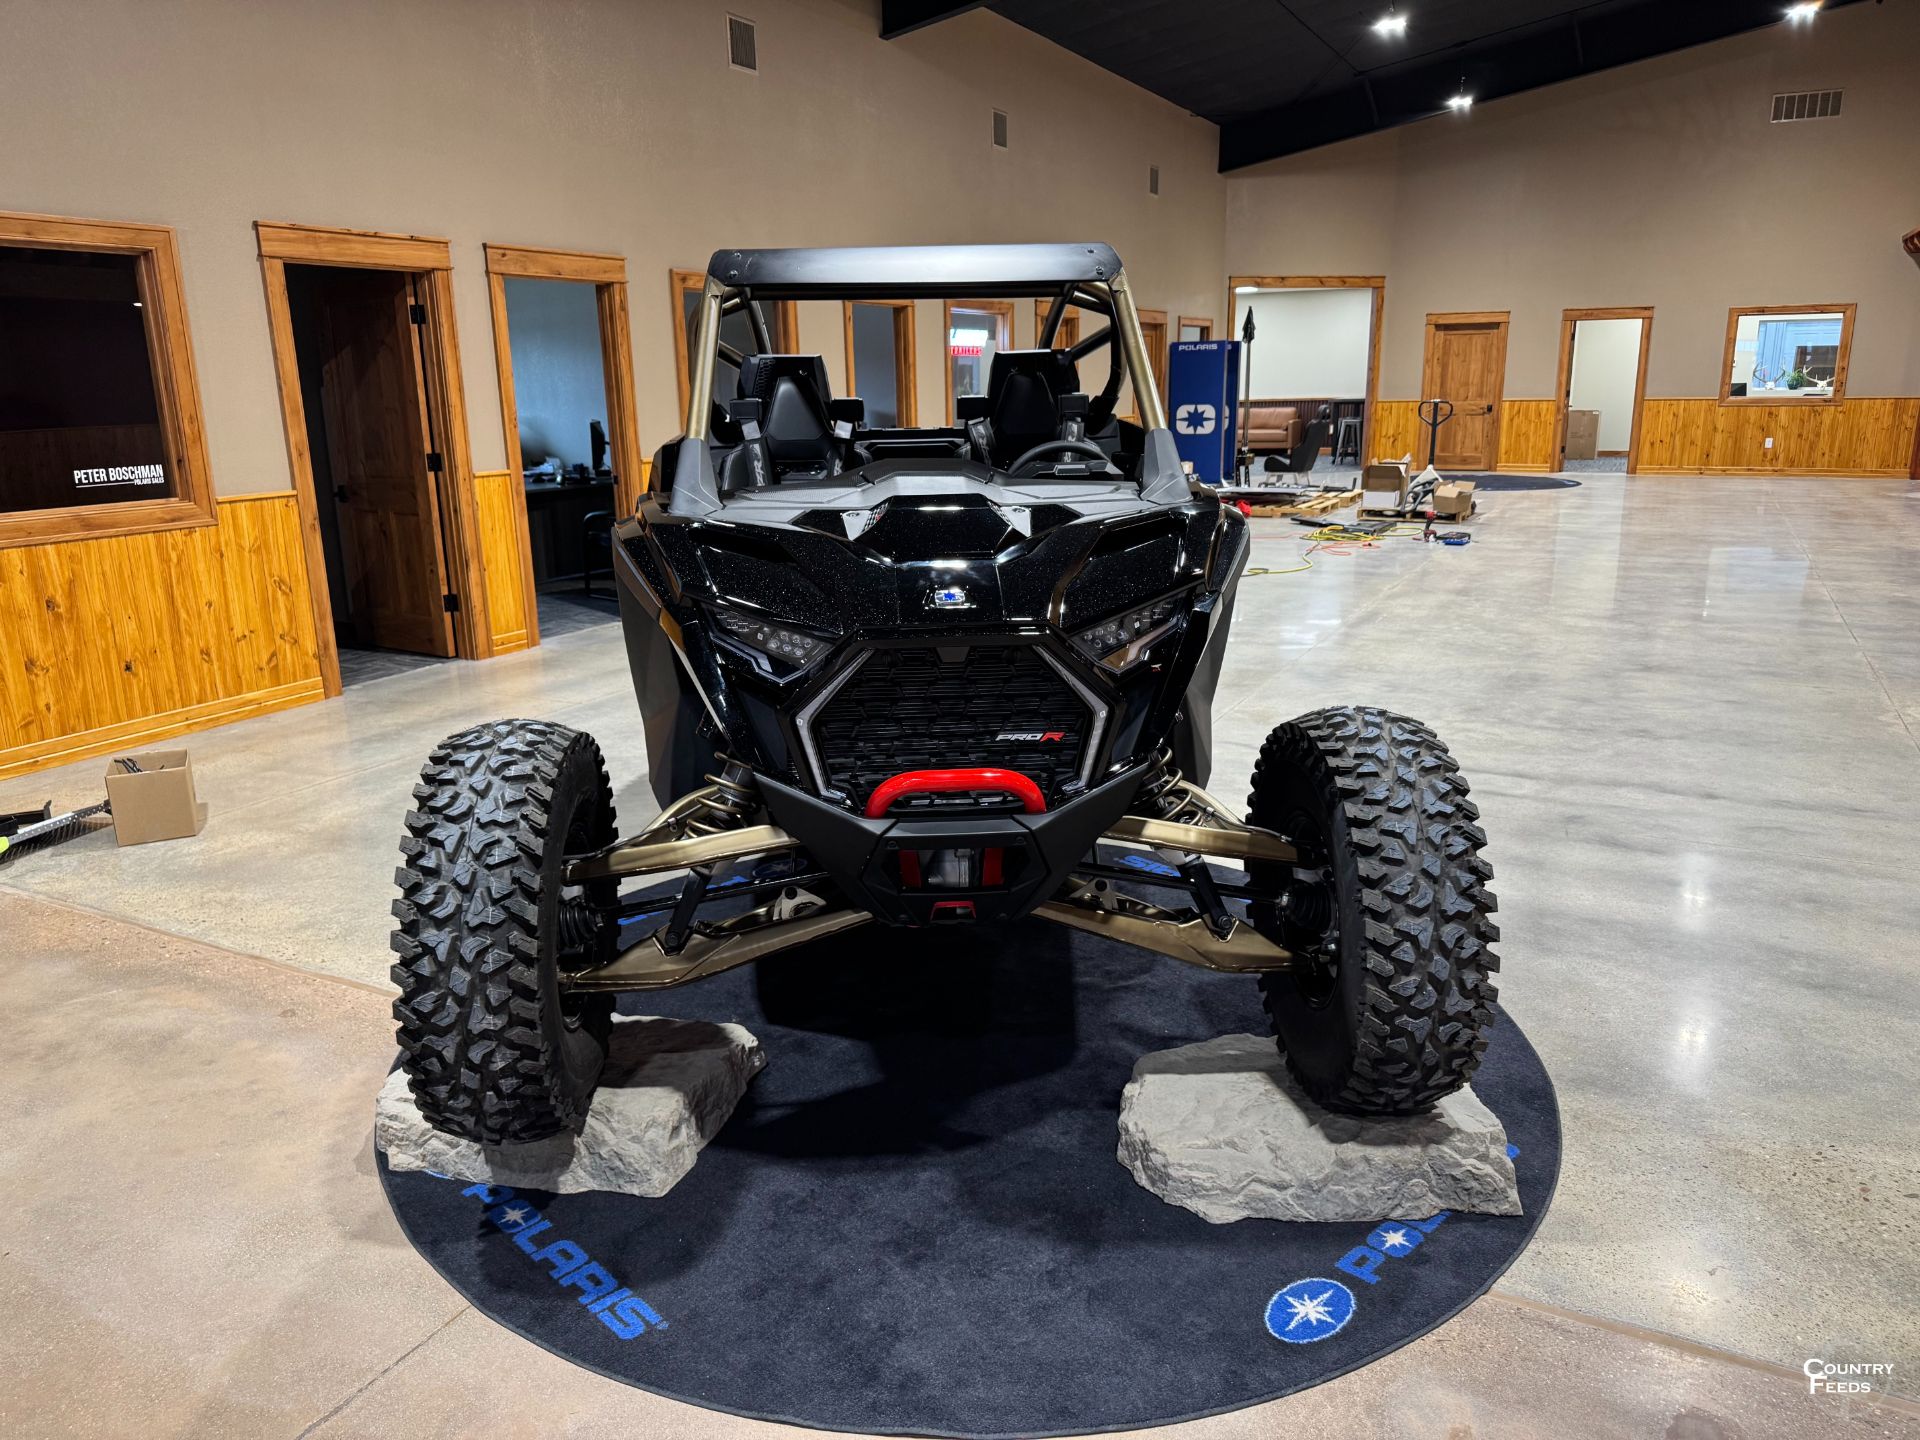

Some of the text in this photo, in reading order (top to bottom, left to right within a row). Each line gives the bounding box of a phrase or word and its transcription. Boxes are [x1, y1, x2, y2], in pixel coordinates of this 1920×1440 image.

[1178, 343, 1218, 351] POLARIS
[73, 464, 164, 484] PETER BOSCHMAN
[134, 478, 151, 486] POLARIS
